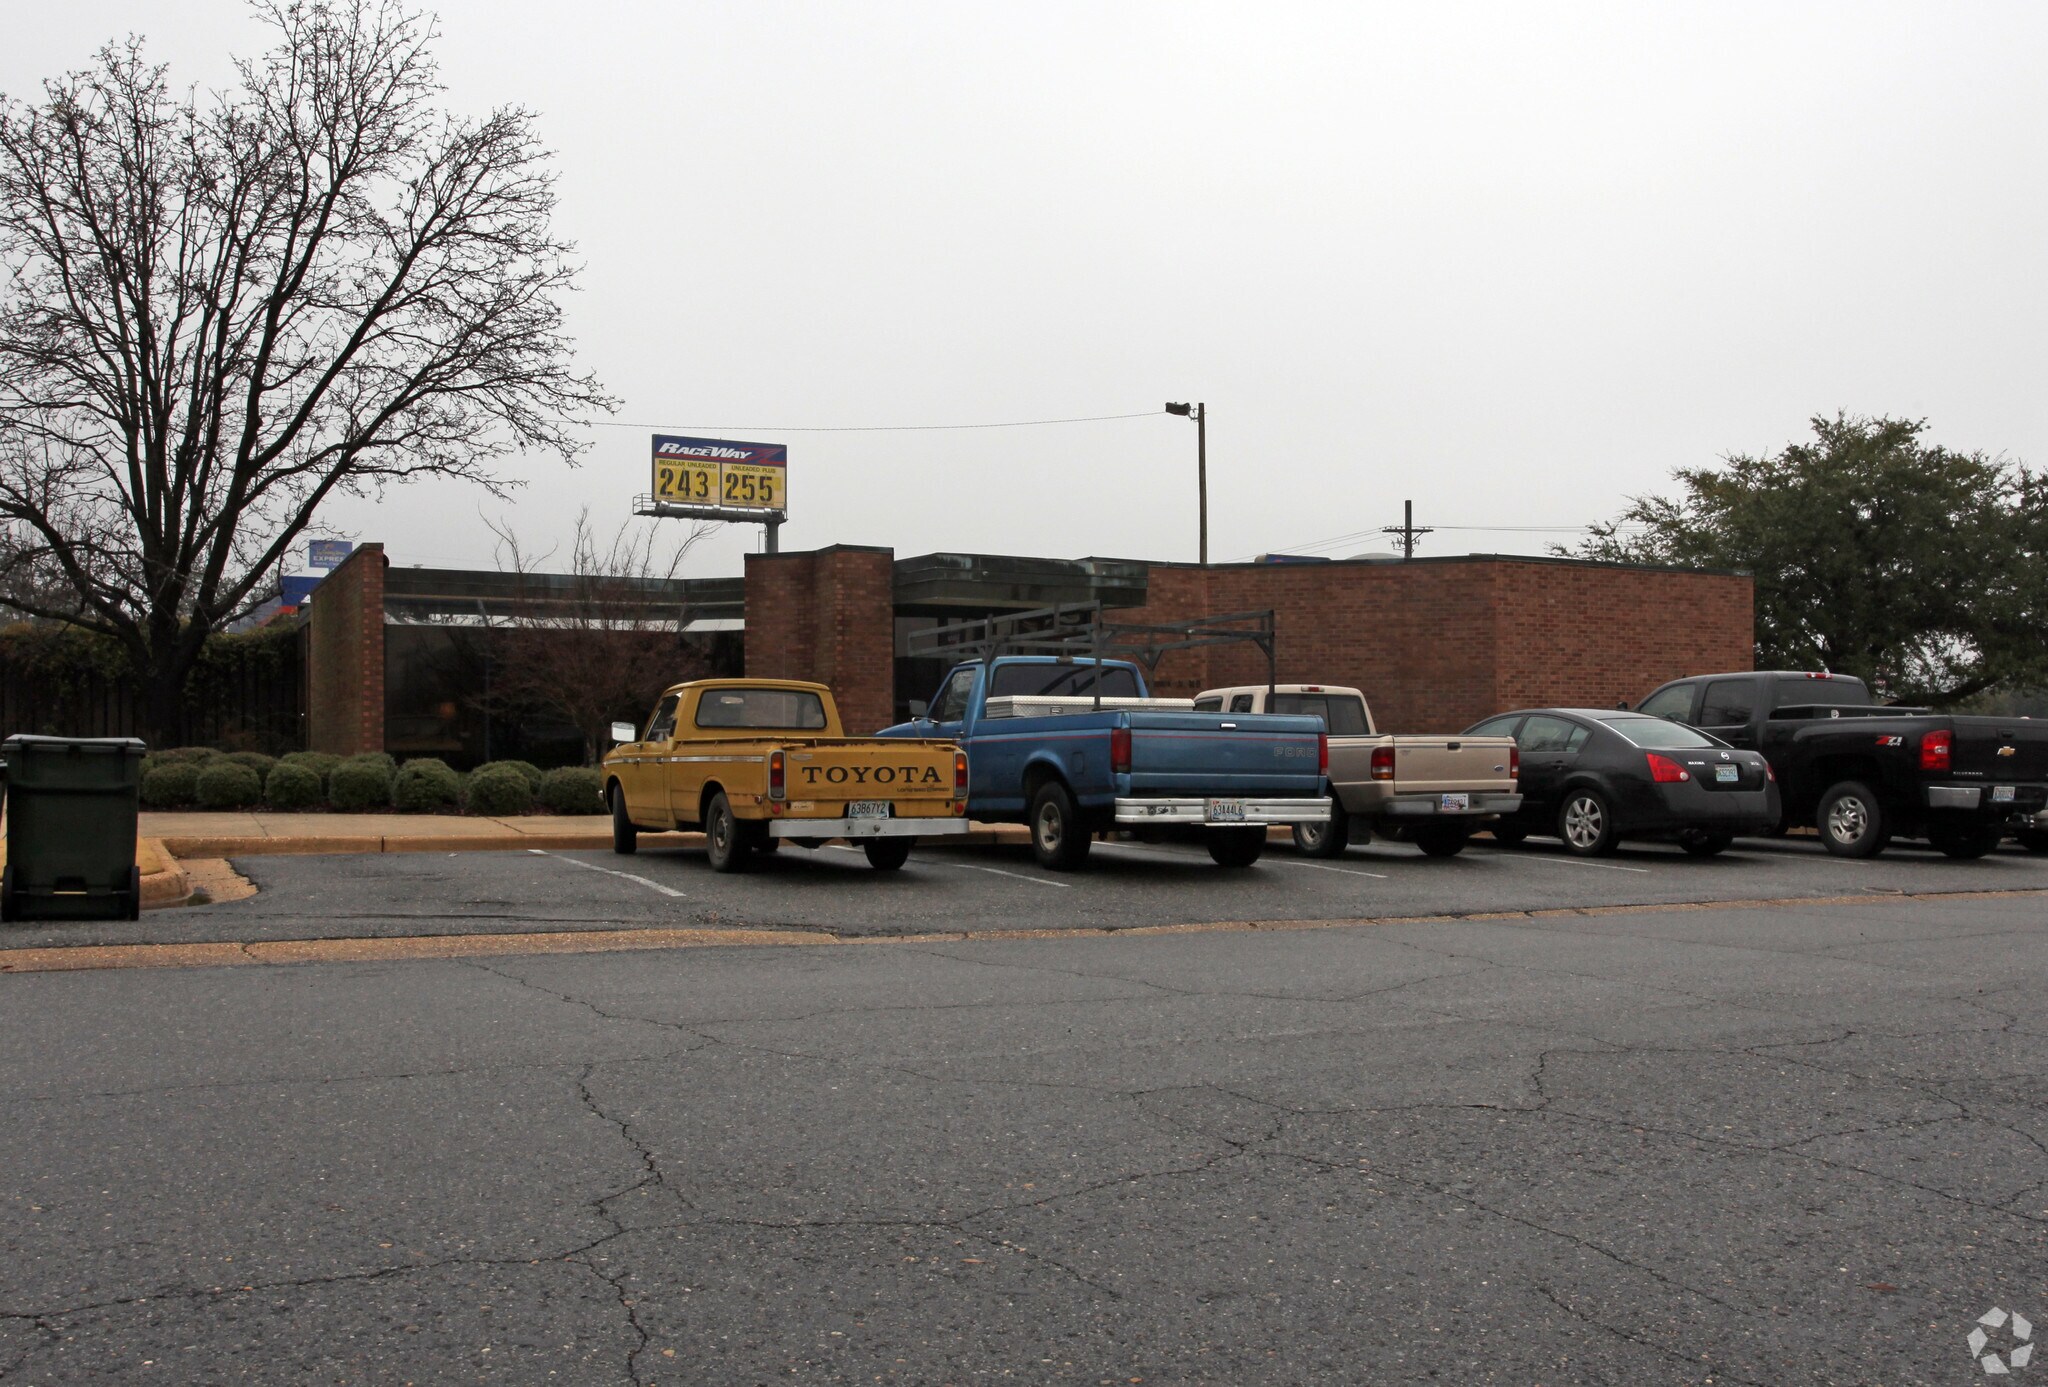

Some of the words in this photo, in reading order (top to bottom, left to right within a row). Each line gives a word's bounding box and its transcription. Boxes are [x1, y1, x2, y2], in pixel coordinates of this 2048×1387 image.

[731, 465, 760, 473] UNLEADED
[660, 468, 709, 497] 243
[726, 473, 772, 501] 255
[1273, 746, 1317, 758] FORD
[802, 766, 942, 783] TOYOTA
